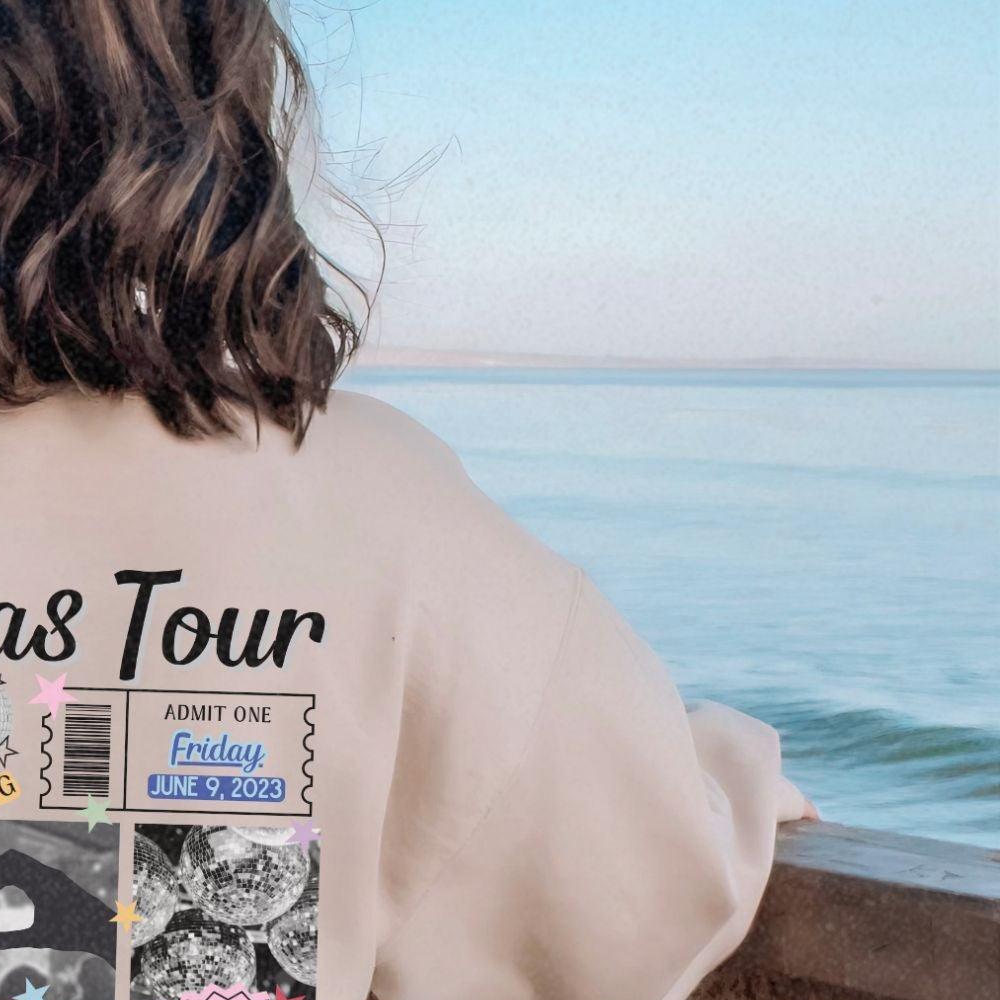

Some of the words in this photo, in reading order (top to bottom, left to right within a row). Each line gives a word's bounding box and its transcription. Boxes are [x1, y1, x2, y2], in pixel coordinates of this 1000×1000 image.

[113, 568, 326, 682] Tour
[164, 704, 226, 722] ADMIT
[234, 706, 272, 723] ONE
[170, 731, 265, 774] Friday
[150, 775, 198, 797] JUNE
[205, 777, 225, 800] 9,
[231, 778, 283, 799] 2023
